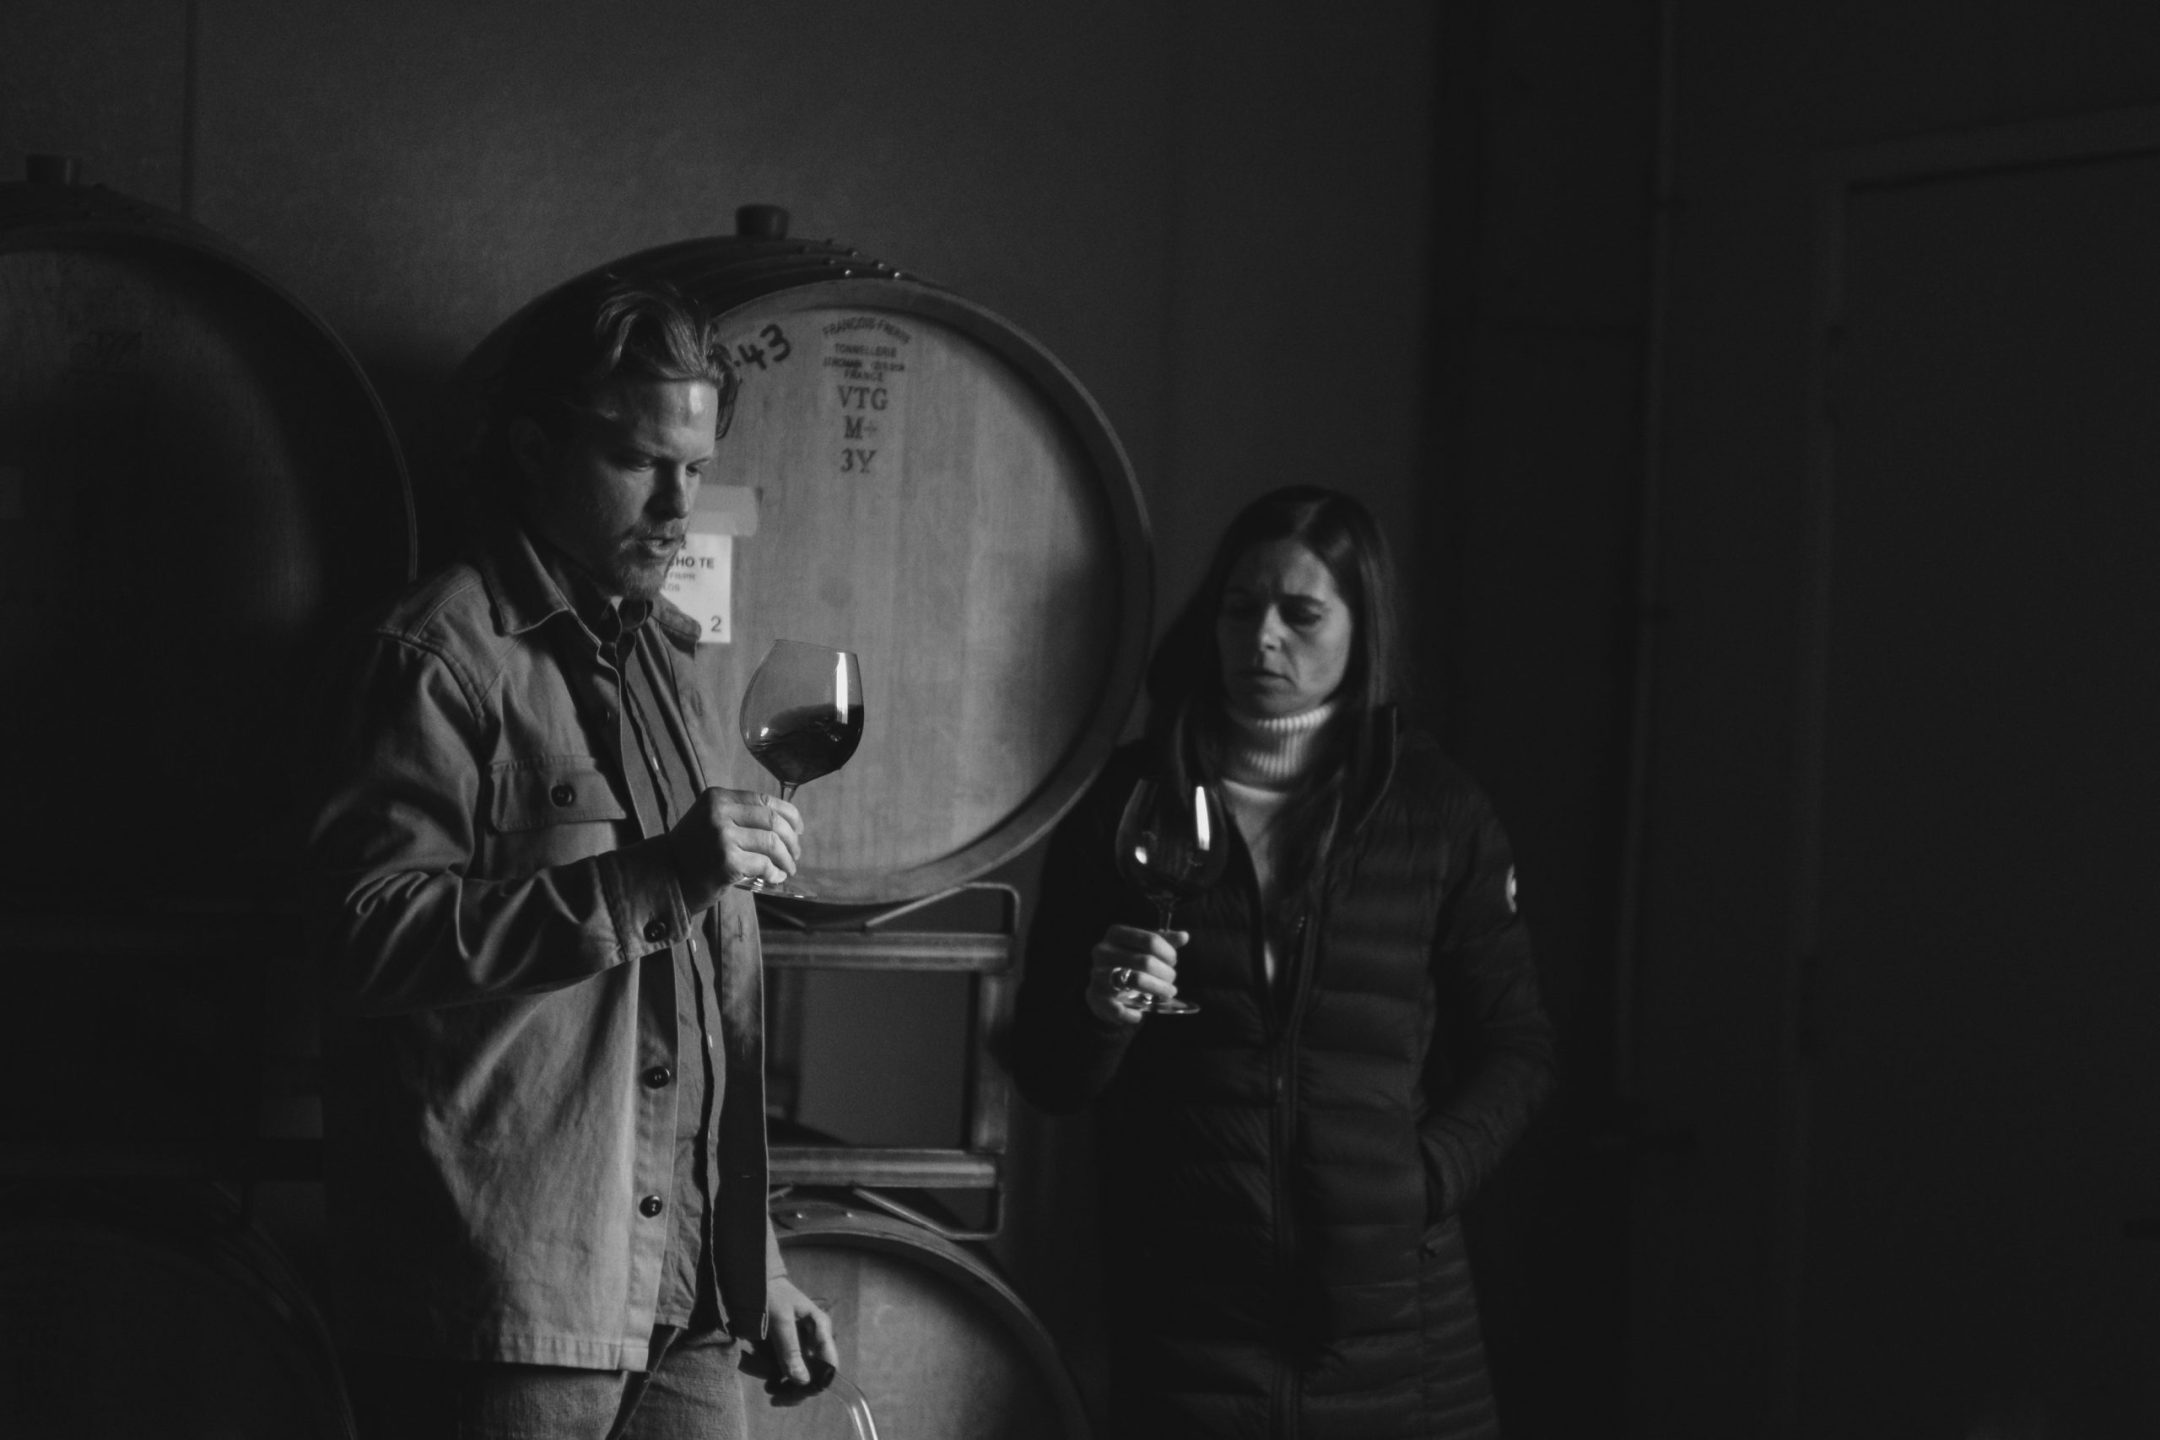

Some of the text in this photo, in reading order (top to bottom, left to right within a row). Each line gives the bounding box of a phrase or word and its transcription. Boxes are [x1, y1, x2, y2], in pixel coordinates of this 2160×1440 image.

[837, 385, 888, 411] VTG
[840, 448, 877, 474] 3Y
[699, 557, 715, 570] TE
[711, 616, 722, 633] 2
